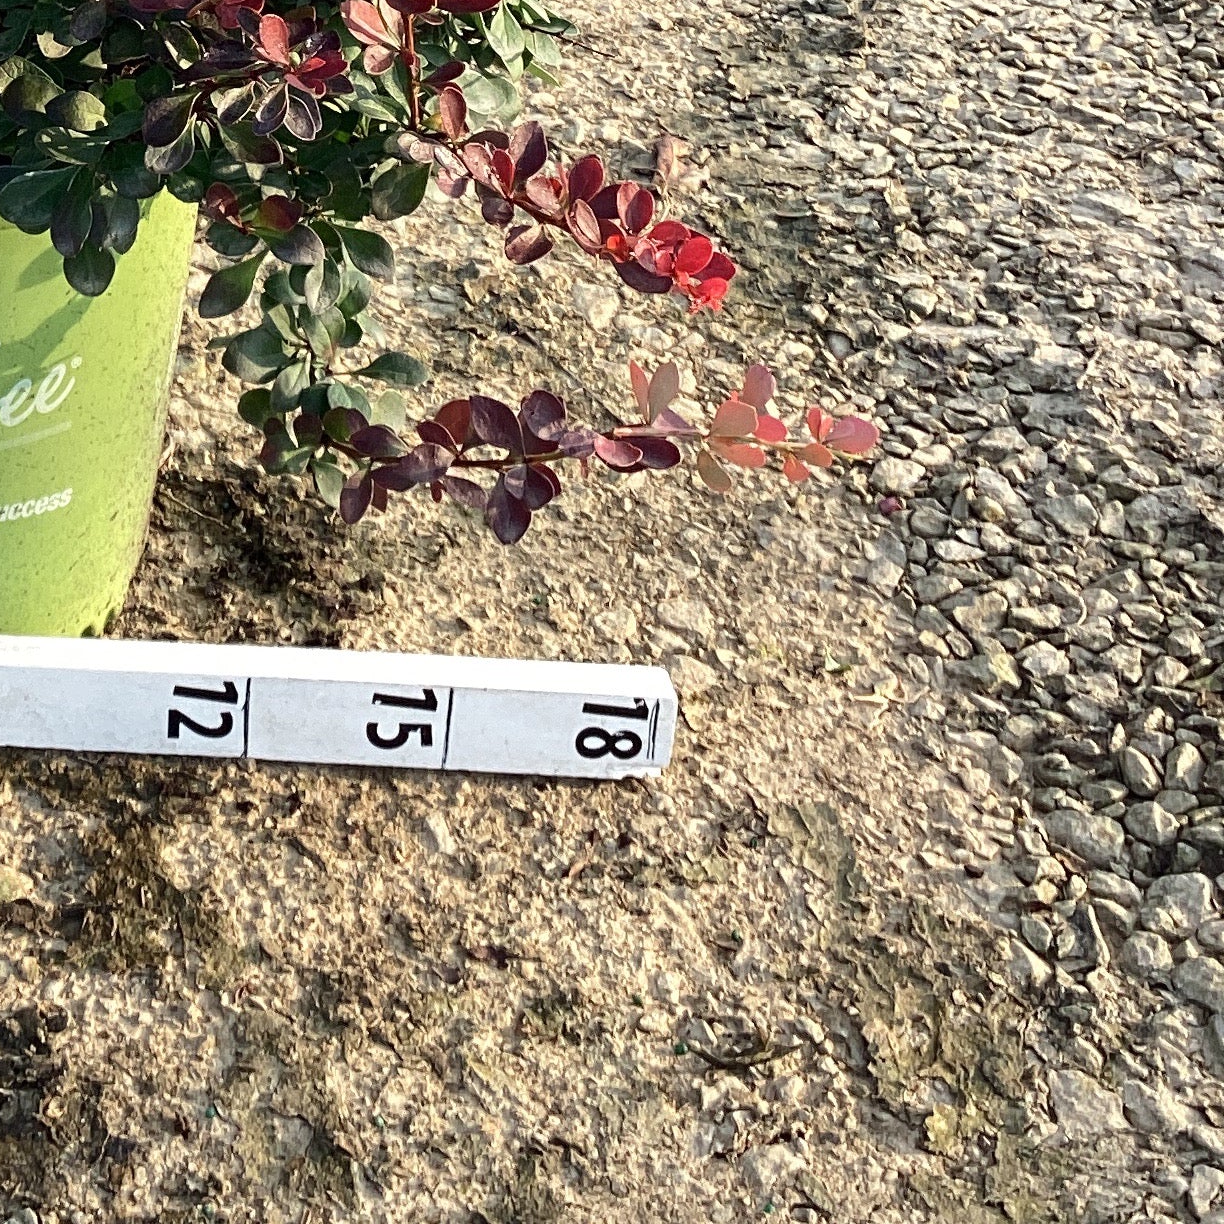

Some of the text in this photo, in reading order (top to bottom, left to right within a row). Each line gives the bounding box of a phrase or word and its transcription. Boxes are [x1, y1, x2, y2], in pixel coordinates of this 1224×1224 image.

[167, 680, 239, 739] 12
[366, 688, 438, 750] 15
[575, 698, 649, 760] 18
